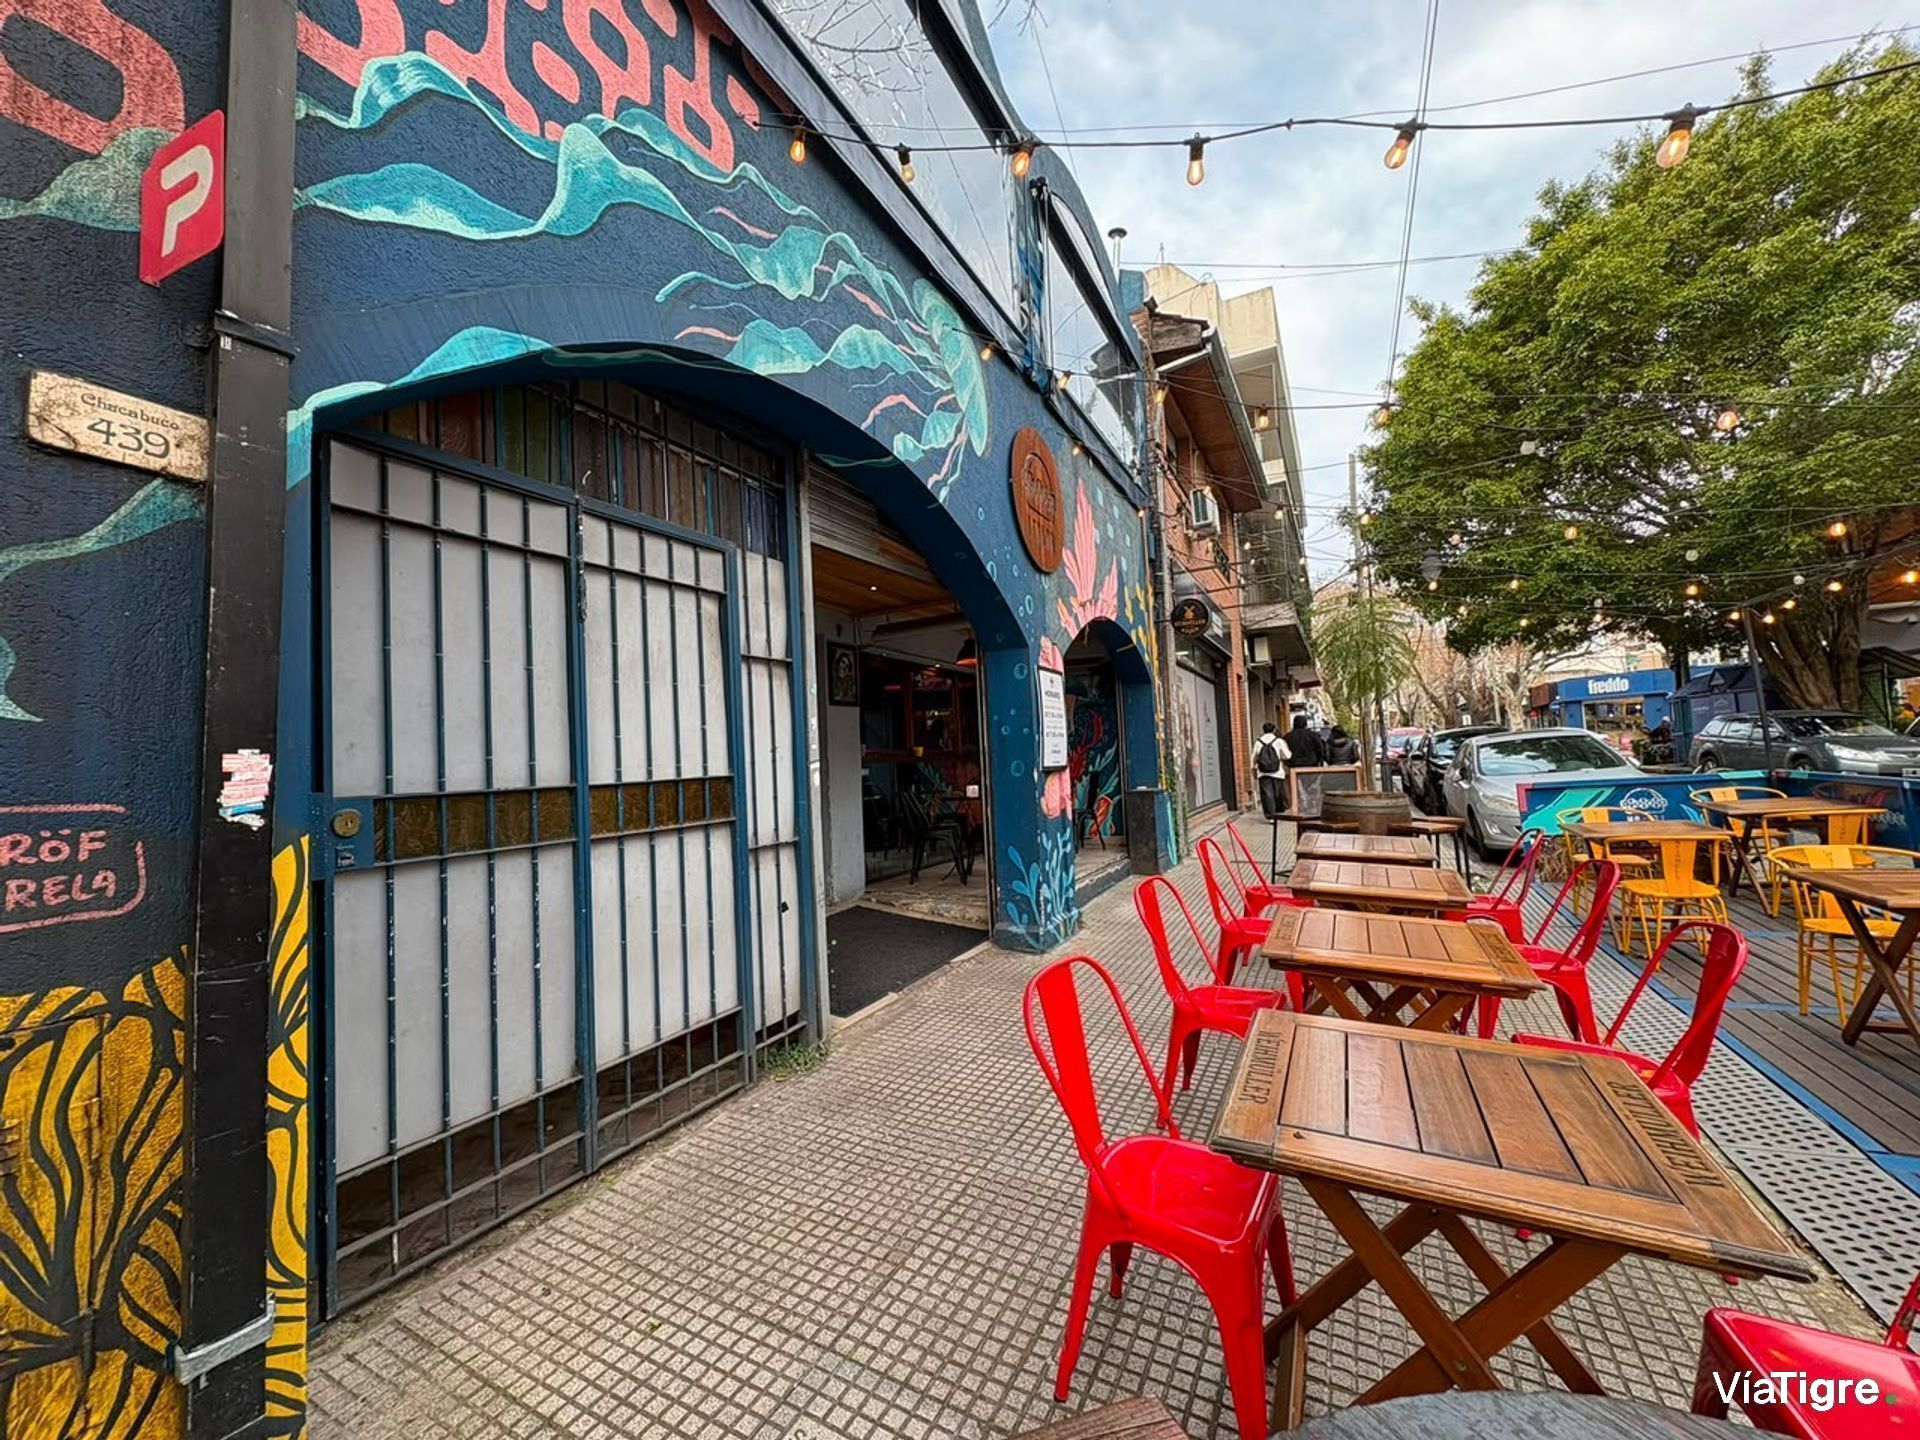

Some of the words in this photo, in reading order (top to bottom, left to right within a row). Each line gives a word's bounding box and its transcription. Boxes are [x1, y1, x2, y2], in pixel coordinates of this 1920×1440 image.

[80, 392, 181, 432] Chacabuco
[86, 417, 171, 460] 439
[1588, 676, 1630, 695] freddo
